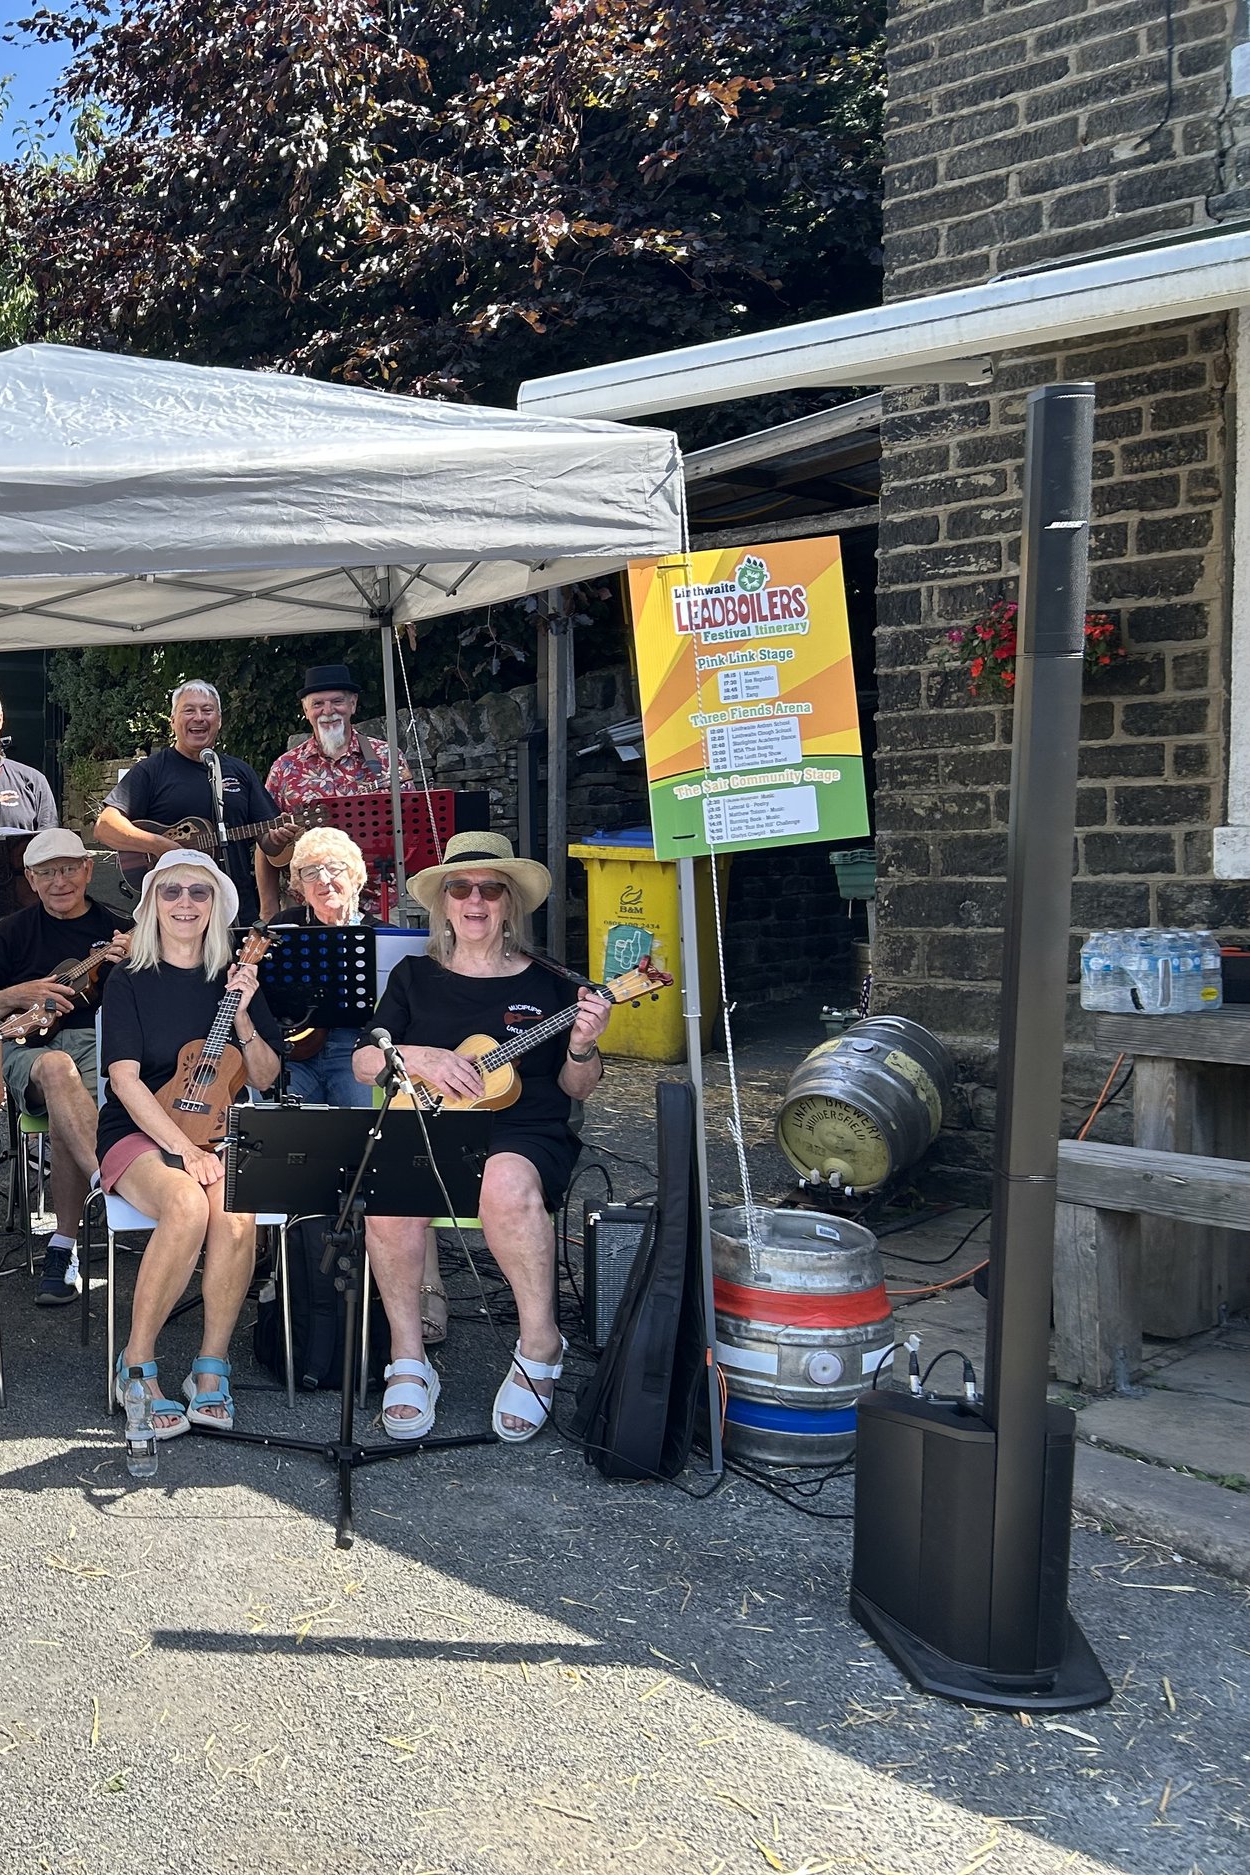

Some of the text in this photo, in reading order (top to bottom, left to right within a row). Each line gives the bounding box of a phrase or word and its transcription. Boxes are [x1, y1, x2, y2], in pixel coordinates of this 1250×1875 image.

[674, 583, 736, 598] Linthwaite
[676, 587, 806, 632] LEADBOILERS
[703, 621, 807, 642] Festival Itinerary
[697, 649, 793, 669] Pink Link Stage
[690, 702, 811, 726] Three Fiends Arena
[675, 767, 840, 799] The Sair Community Stage
[619, 905, 644, 914] B&M
[791, 1097, 883, 1142] LINFIT BREWERY
[805, 1109, 867, 1142] HUDDERSFIELD
